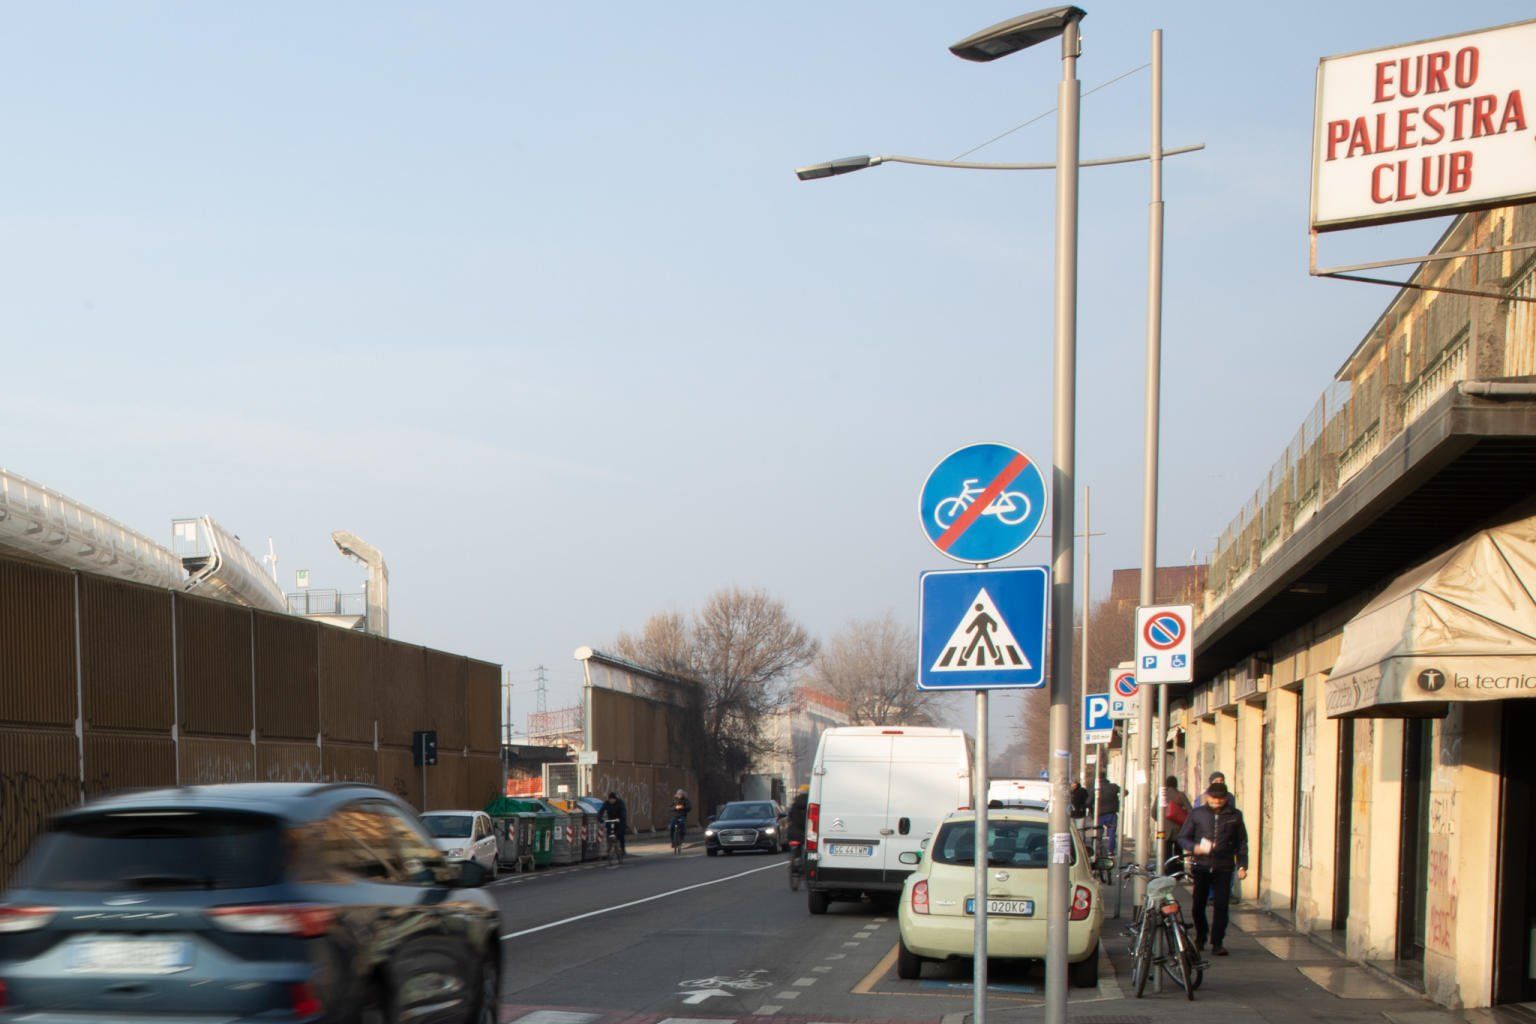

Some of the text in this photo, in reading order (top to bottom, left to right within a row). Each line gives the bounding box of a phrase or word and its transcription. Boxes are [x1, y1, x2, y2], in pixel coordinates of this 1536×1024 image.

[1372, 46, 1480, 104] EURO
[1325, 89, 1528, 162] PALESTRA
[1370, 150, 1474, 204] CLUB
[1454, 672, 1470, 689] la
[1089, 697, 1108, 728] P
